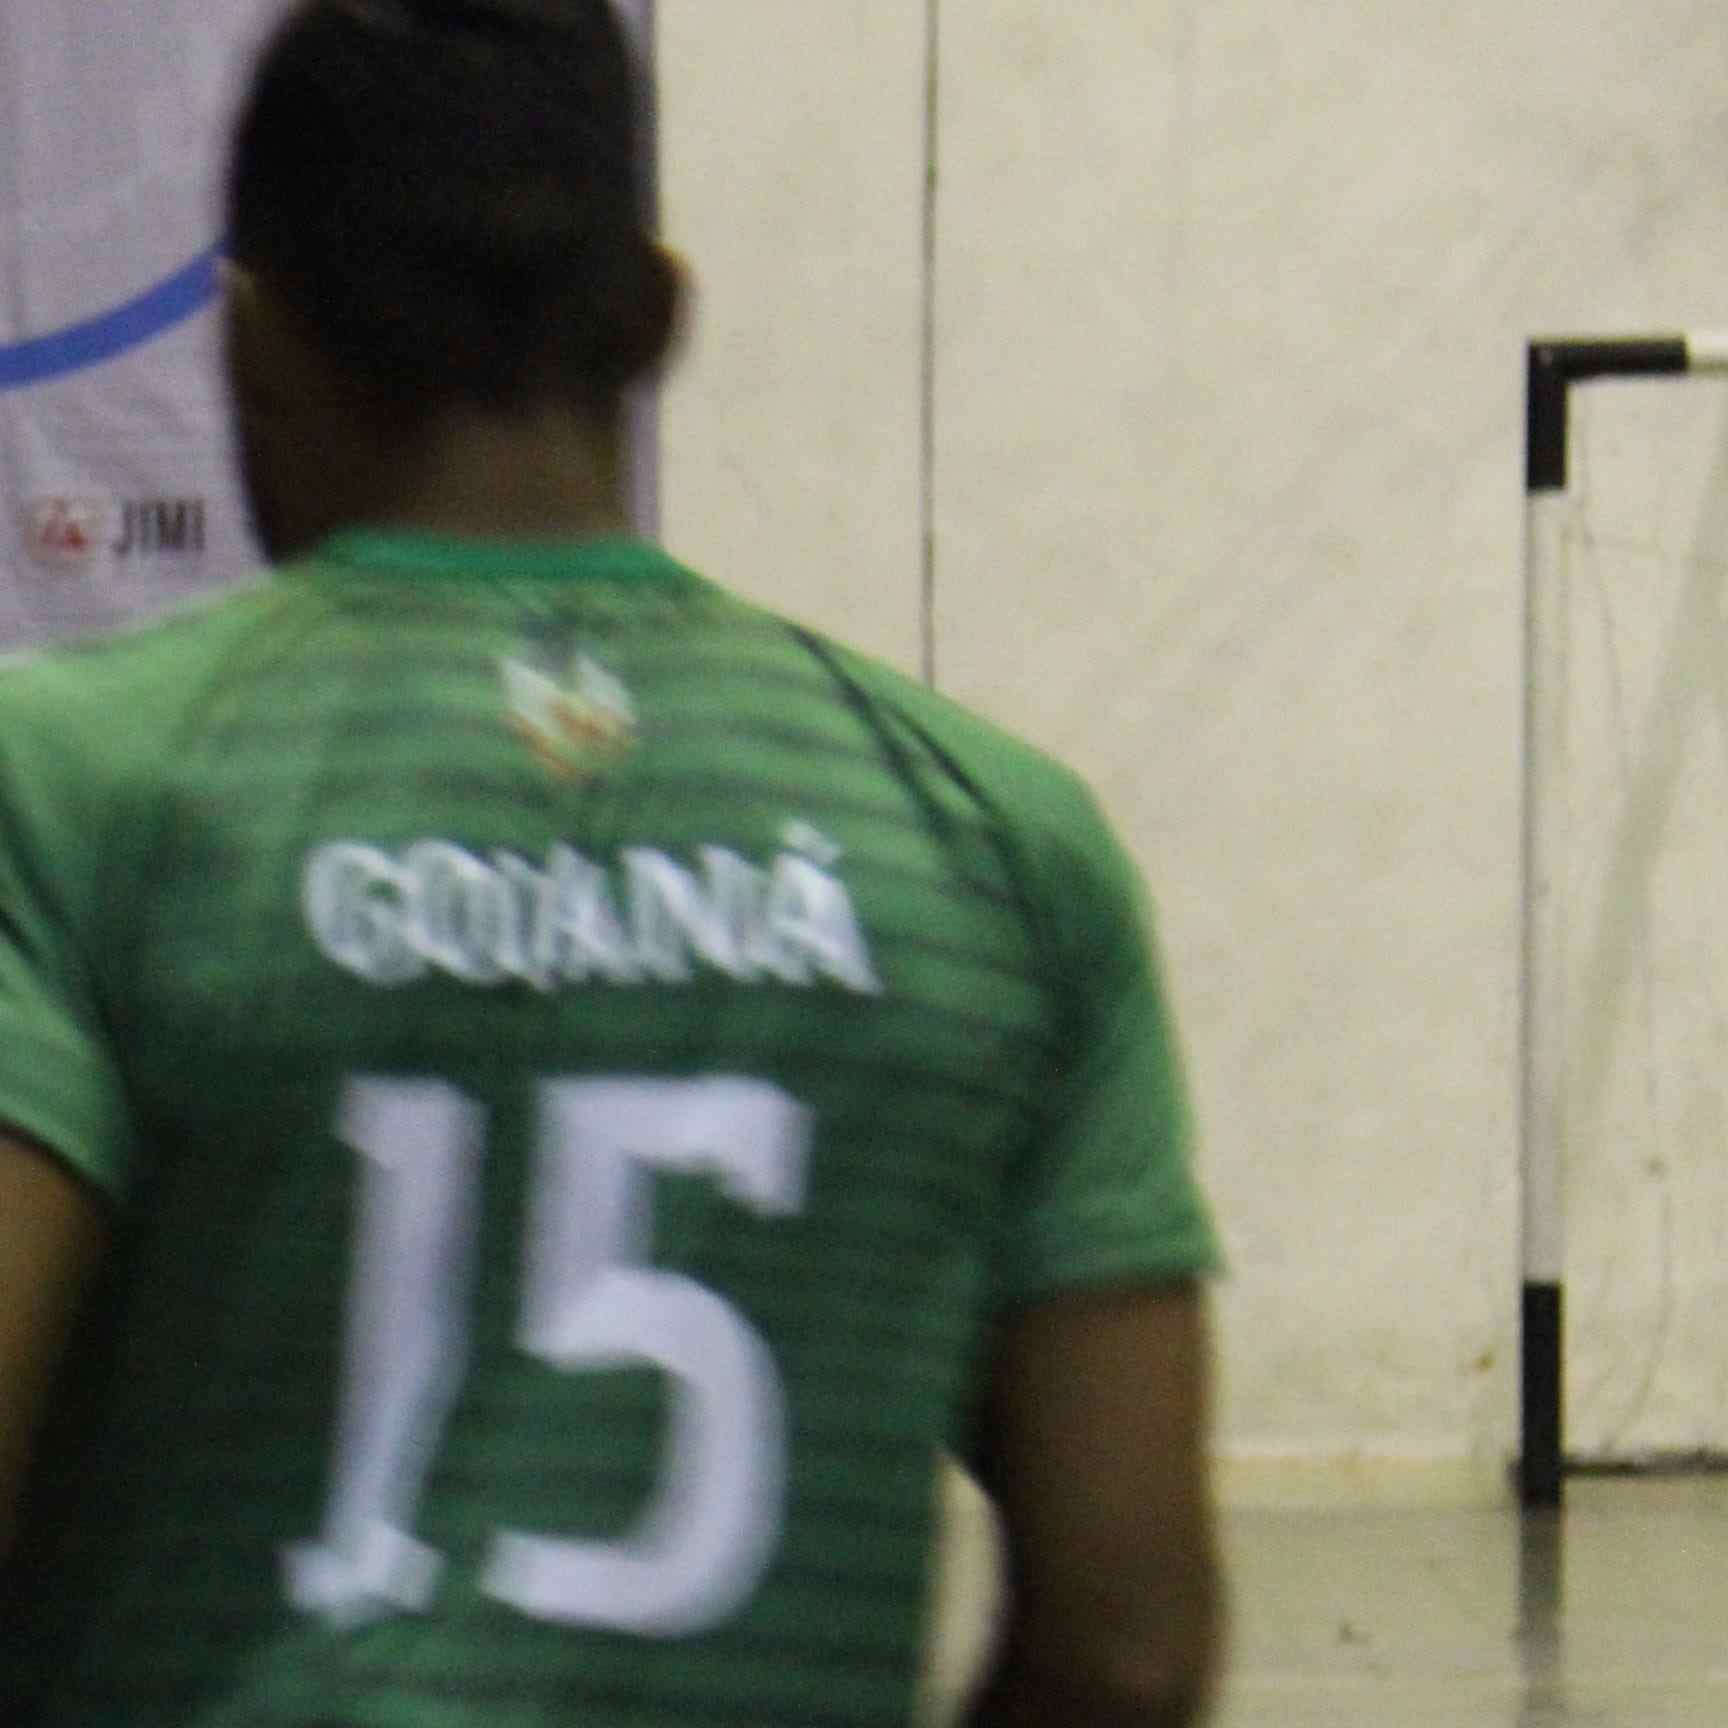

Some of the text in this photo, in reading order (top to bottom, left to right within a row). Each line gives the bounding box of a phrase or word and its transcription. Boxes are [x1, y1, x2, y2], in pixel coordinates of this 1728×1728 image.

[112, 497, 206, 556] JIMI
[299, 819, 882, 997] GOIANÁ
[278, 1072, 814, 1638] 15
